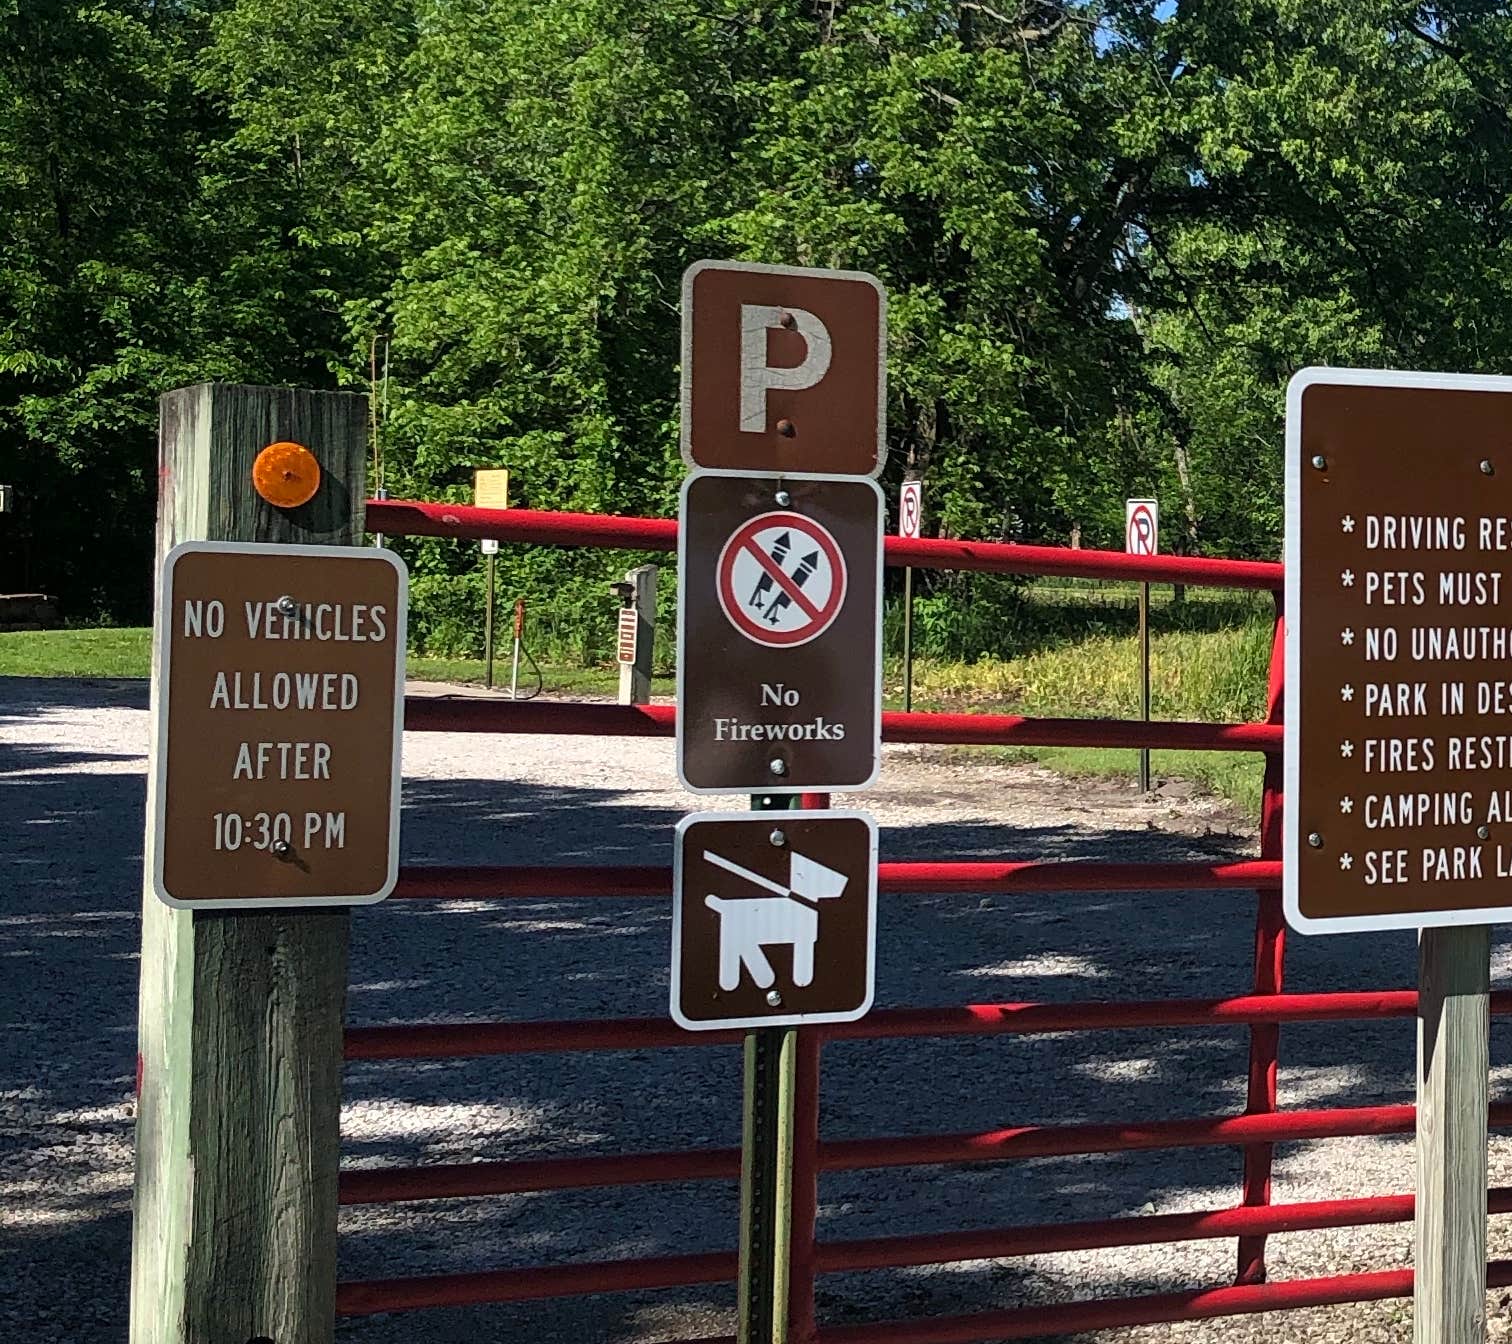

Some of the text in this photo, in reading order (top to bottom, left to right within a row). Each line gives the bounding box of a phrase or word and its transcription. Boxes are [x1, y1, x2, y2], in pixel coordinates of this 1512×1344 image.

[740, 304, 832, 433] P
[1366, 515, 1465, 550] DRIVING
[1366, 571, 1425, 605] PETS
[1439, 572, 1502, 605] MUST
[184, 599, 386, 642] NO VEHICLES
[1366, 627, 1397, 661] NO
[209, 671, 358, 710] ALLOWED
[760, 683, 800, 707] No
[1365, 683, 1427, 717] PARK
[1441, 682, 1464, 715] IN
[713, 716, 846, 741] Fireworks
[233, 742, 331, 780] AFTER
[1365, 738, 1434, 773] FIRES
[1365, 791, 1473, 829] CAMPING
[213, 812, 345, 851] 10:30 PM
[1364, 849, 1408, 885] SEE
[1422, 845, 1484, 882] PARK
